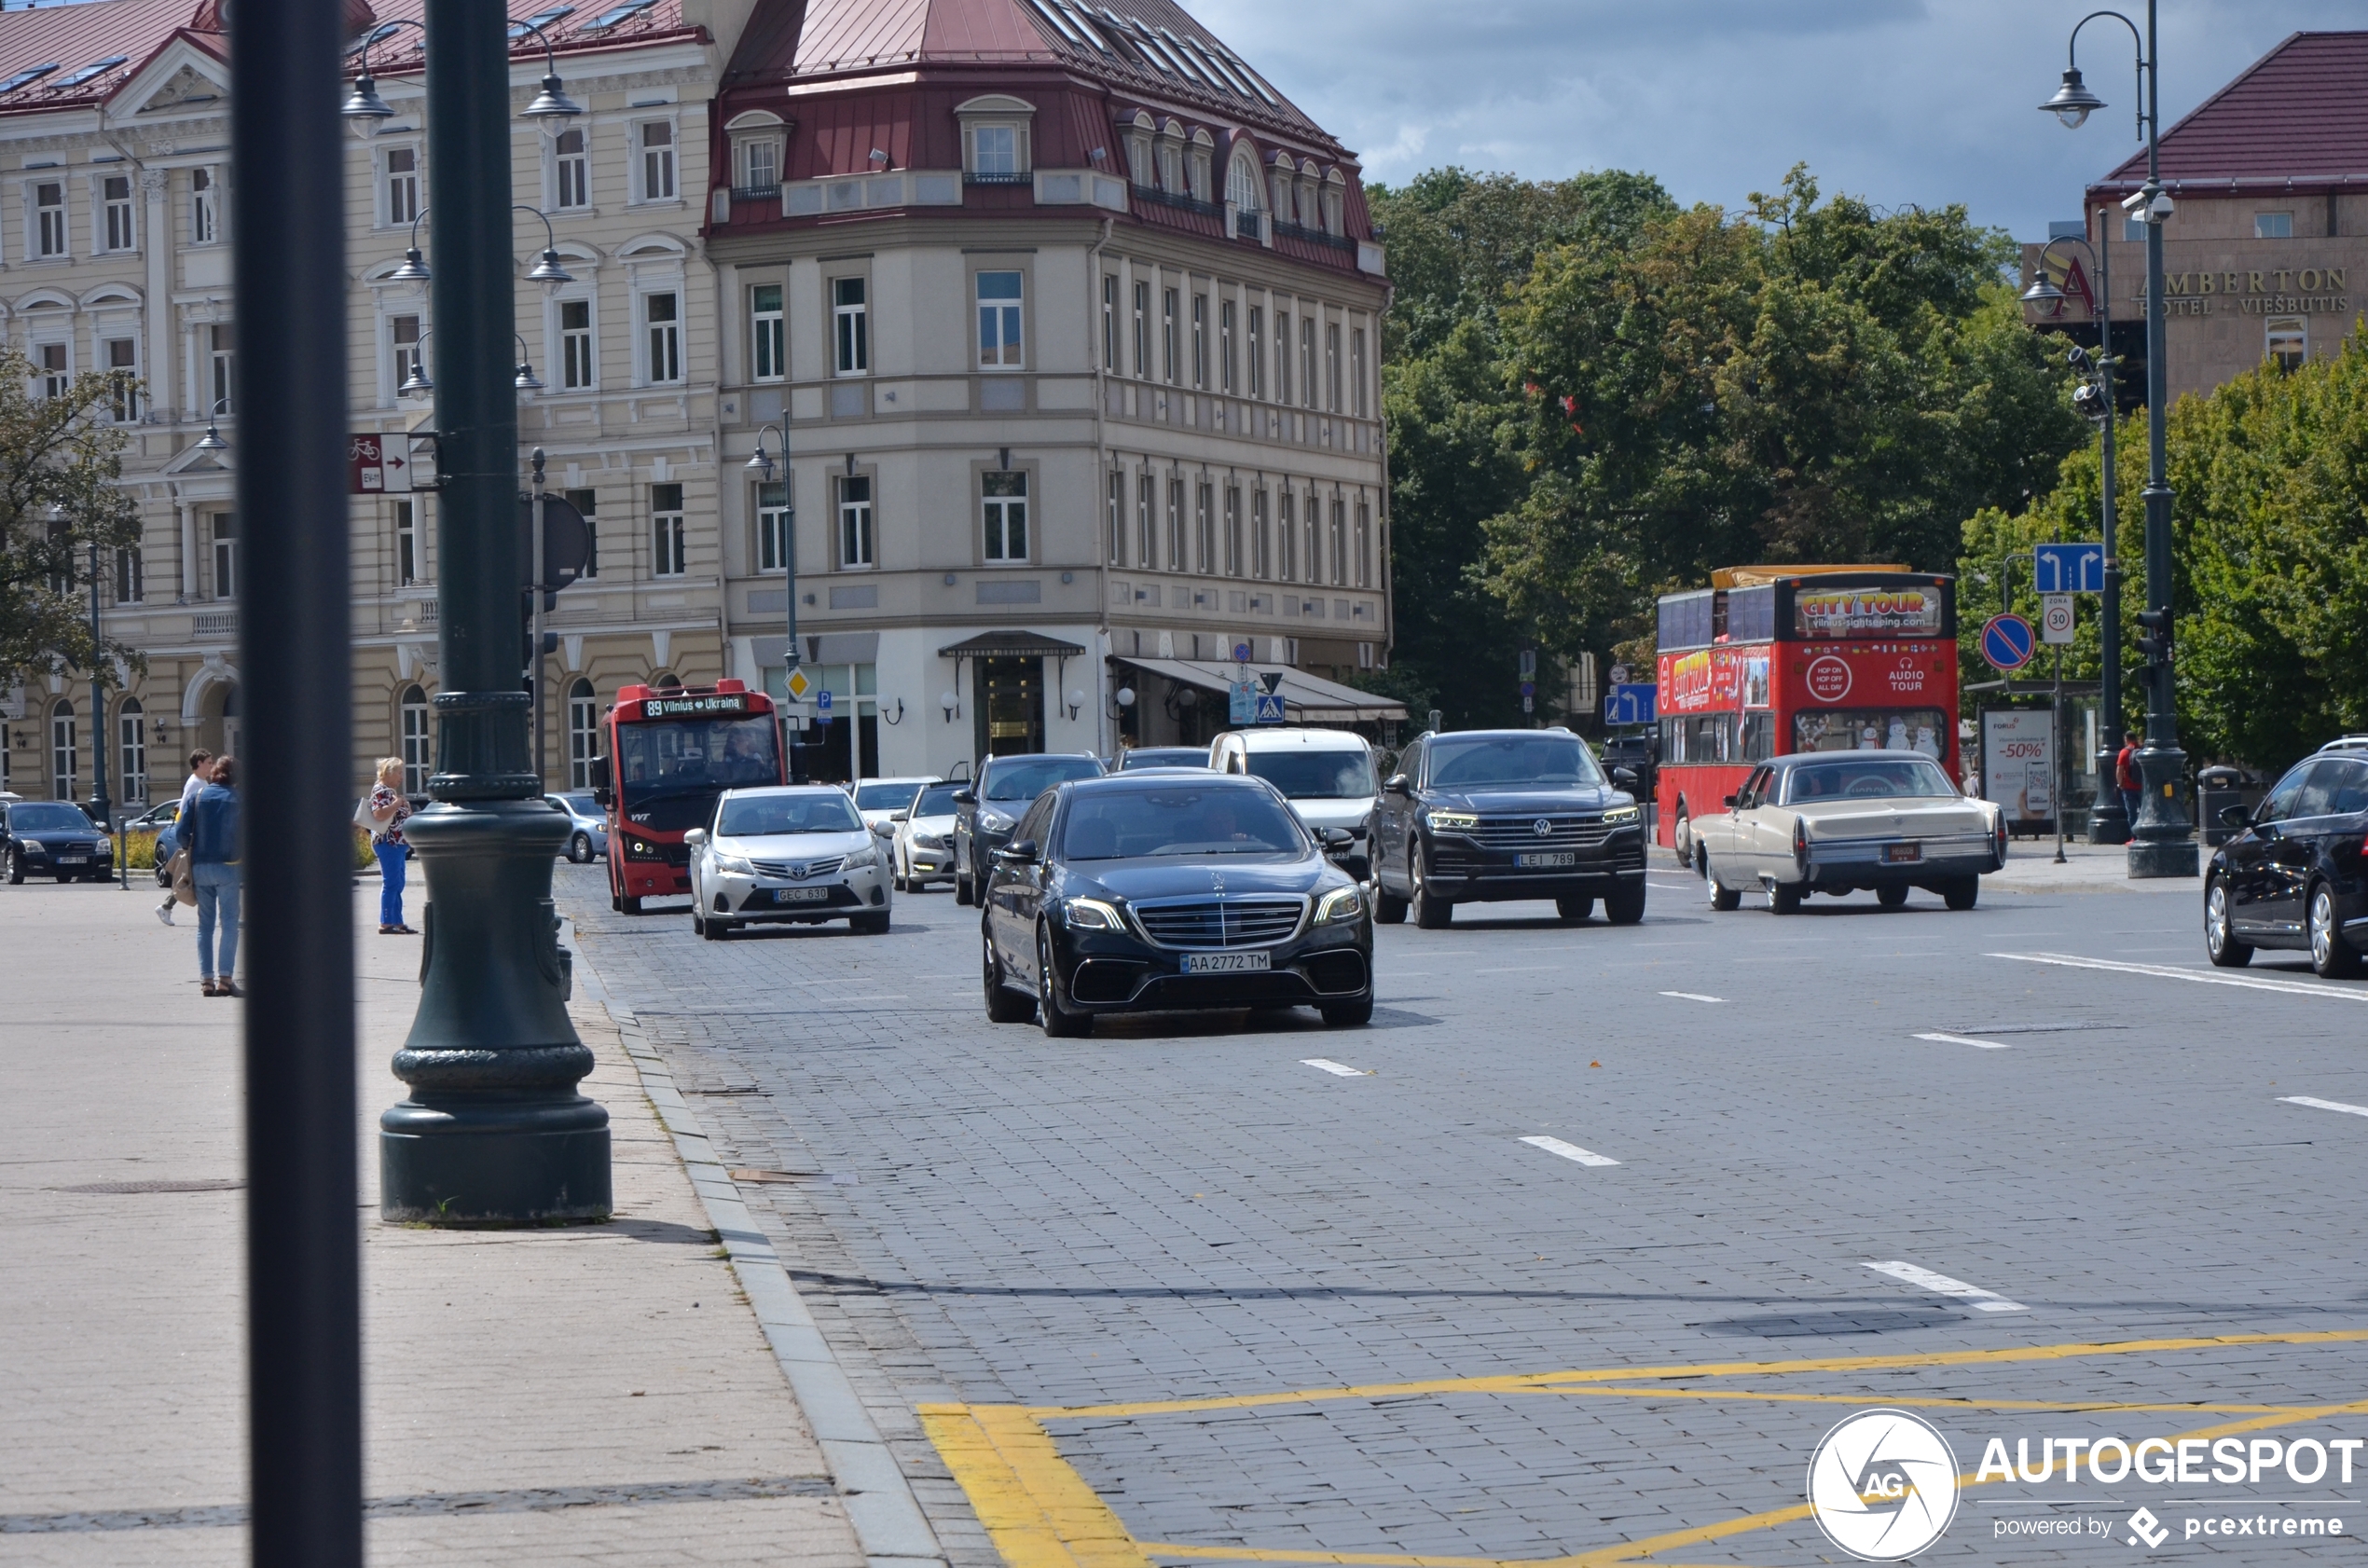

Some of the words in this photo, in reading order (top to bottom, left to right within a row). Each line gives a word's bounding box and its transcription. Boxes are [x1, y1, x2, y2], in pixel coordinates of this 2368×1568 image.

[2240, 295, 2348, 314] VIEŠBUTIS
[1802, 594, 1857, 618] CITY
[1859, 592, 1926, 615] TOUR
[1812, 616, 1926, 629] vilnius-sightseeing.com
[2052, 613, 2065, 625] 30
[1889, 670, 1924, 681] AUDIO
[1891, 681, 1922, 691] TOUR
[647, 700, 663, 717] 89
[663, 700, 694, 712] Vilnius
[705, 696, 740, 709] Ukrainą
[820, 692, 830, 708] P
[1521, 855, 1543, 866] LEI
[1552, 853, 1574, 865] 789
[779, 889, 802, 901] GEC
[807, 887, 827, 899] 630
[1190, 956, 1209, 970] AA
[1211, 955, 1245, 970] 2772
[1247, 954, 1268, 969] TM
